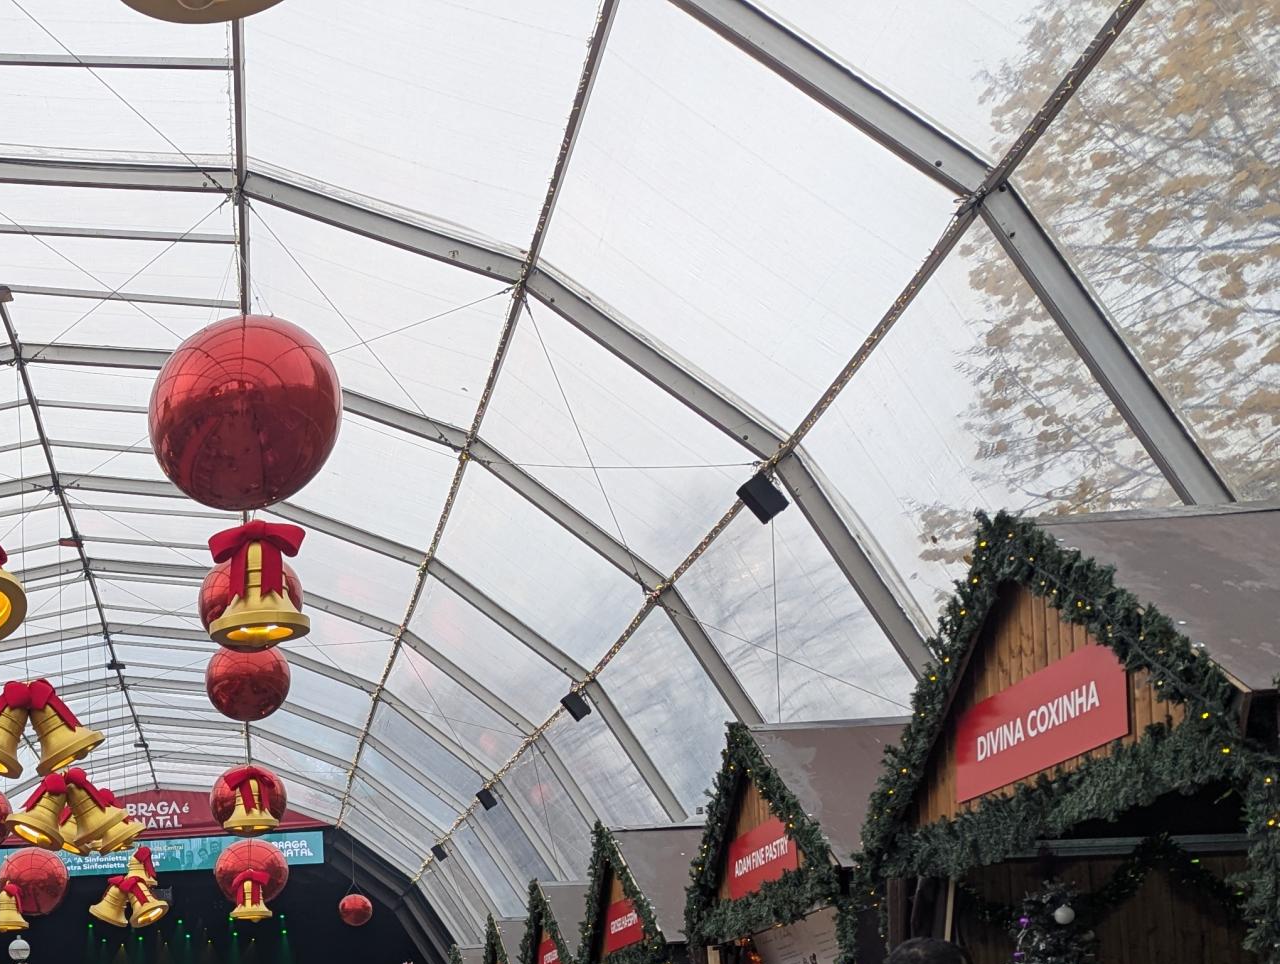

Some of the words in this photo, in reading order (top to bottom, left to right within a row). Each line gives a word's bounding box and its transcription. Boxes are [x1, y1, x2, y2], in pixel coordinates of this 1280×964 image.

[976, 717, 1025, 762] DIVINA
[1026, 680, 1100, 738] COXINHA
[125, 800, 181, 816] BRAGA
[182, 802, 190, 813] é
[84, 855, 127, 863] Sinfonietta
[734, 854, 752, 878] ADAM
[751, 847, 766, 869] FINE
[764, 834, 789, 864] PASTRY
[82, 863, 125, 871] Sinfonietta
